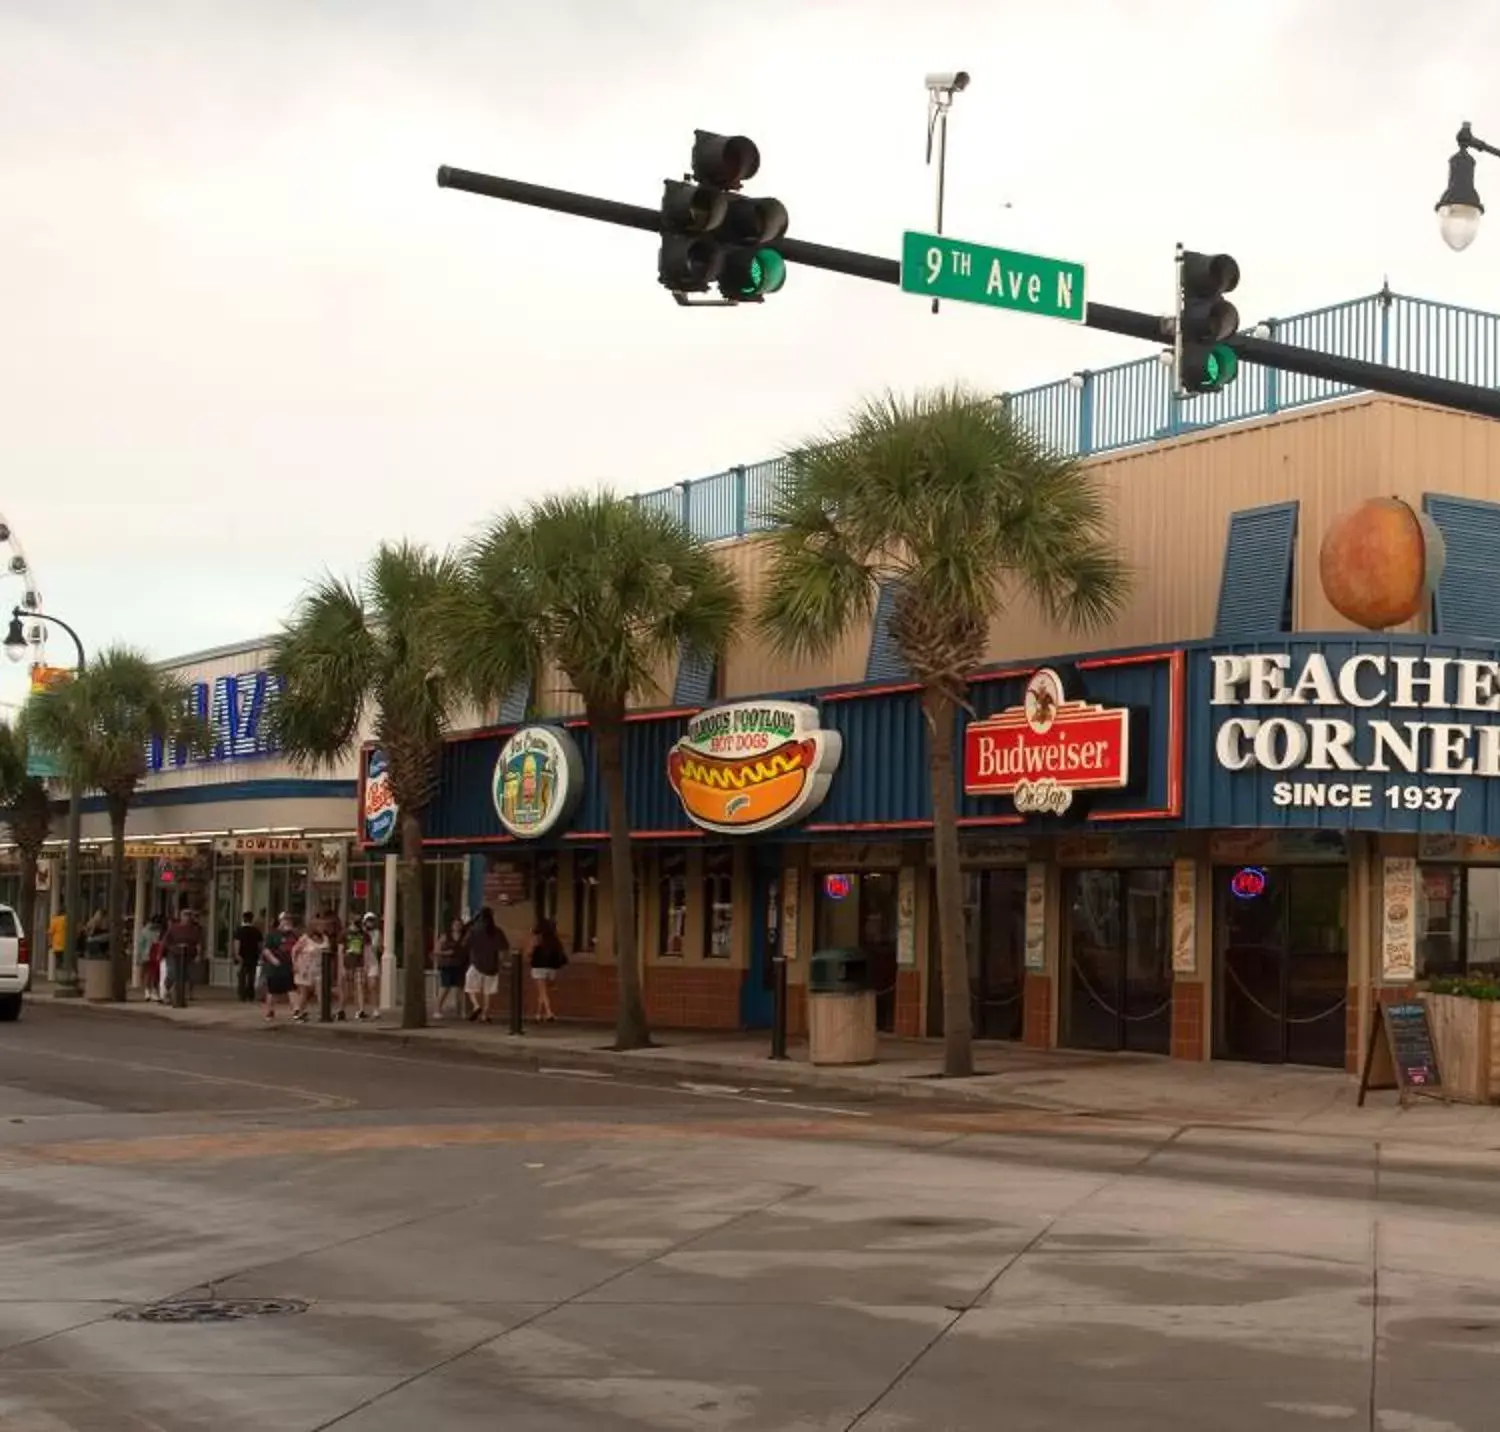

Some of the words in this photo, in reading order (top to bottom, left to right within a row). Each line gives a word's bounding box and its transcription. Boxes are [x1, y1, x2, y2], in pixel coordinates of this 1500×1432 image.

[926, 247, 972, 285] 9TH
[986, 258, 1042, 303] Ave
[1057, 271, 1074, 309] N
[710, 735, 734, 752] HOT
[736, 733, 768, 751] DOGS
[977, 732, 1109, 777] Budweiser
[1273, 781, 1372, 807] SINCE
[1384, 786, 1463, 811] 1937
[236, 839, 301, 850] BOWLING
